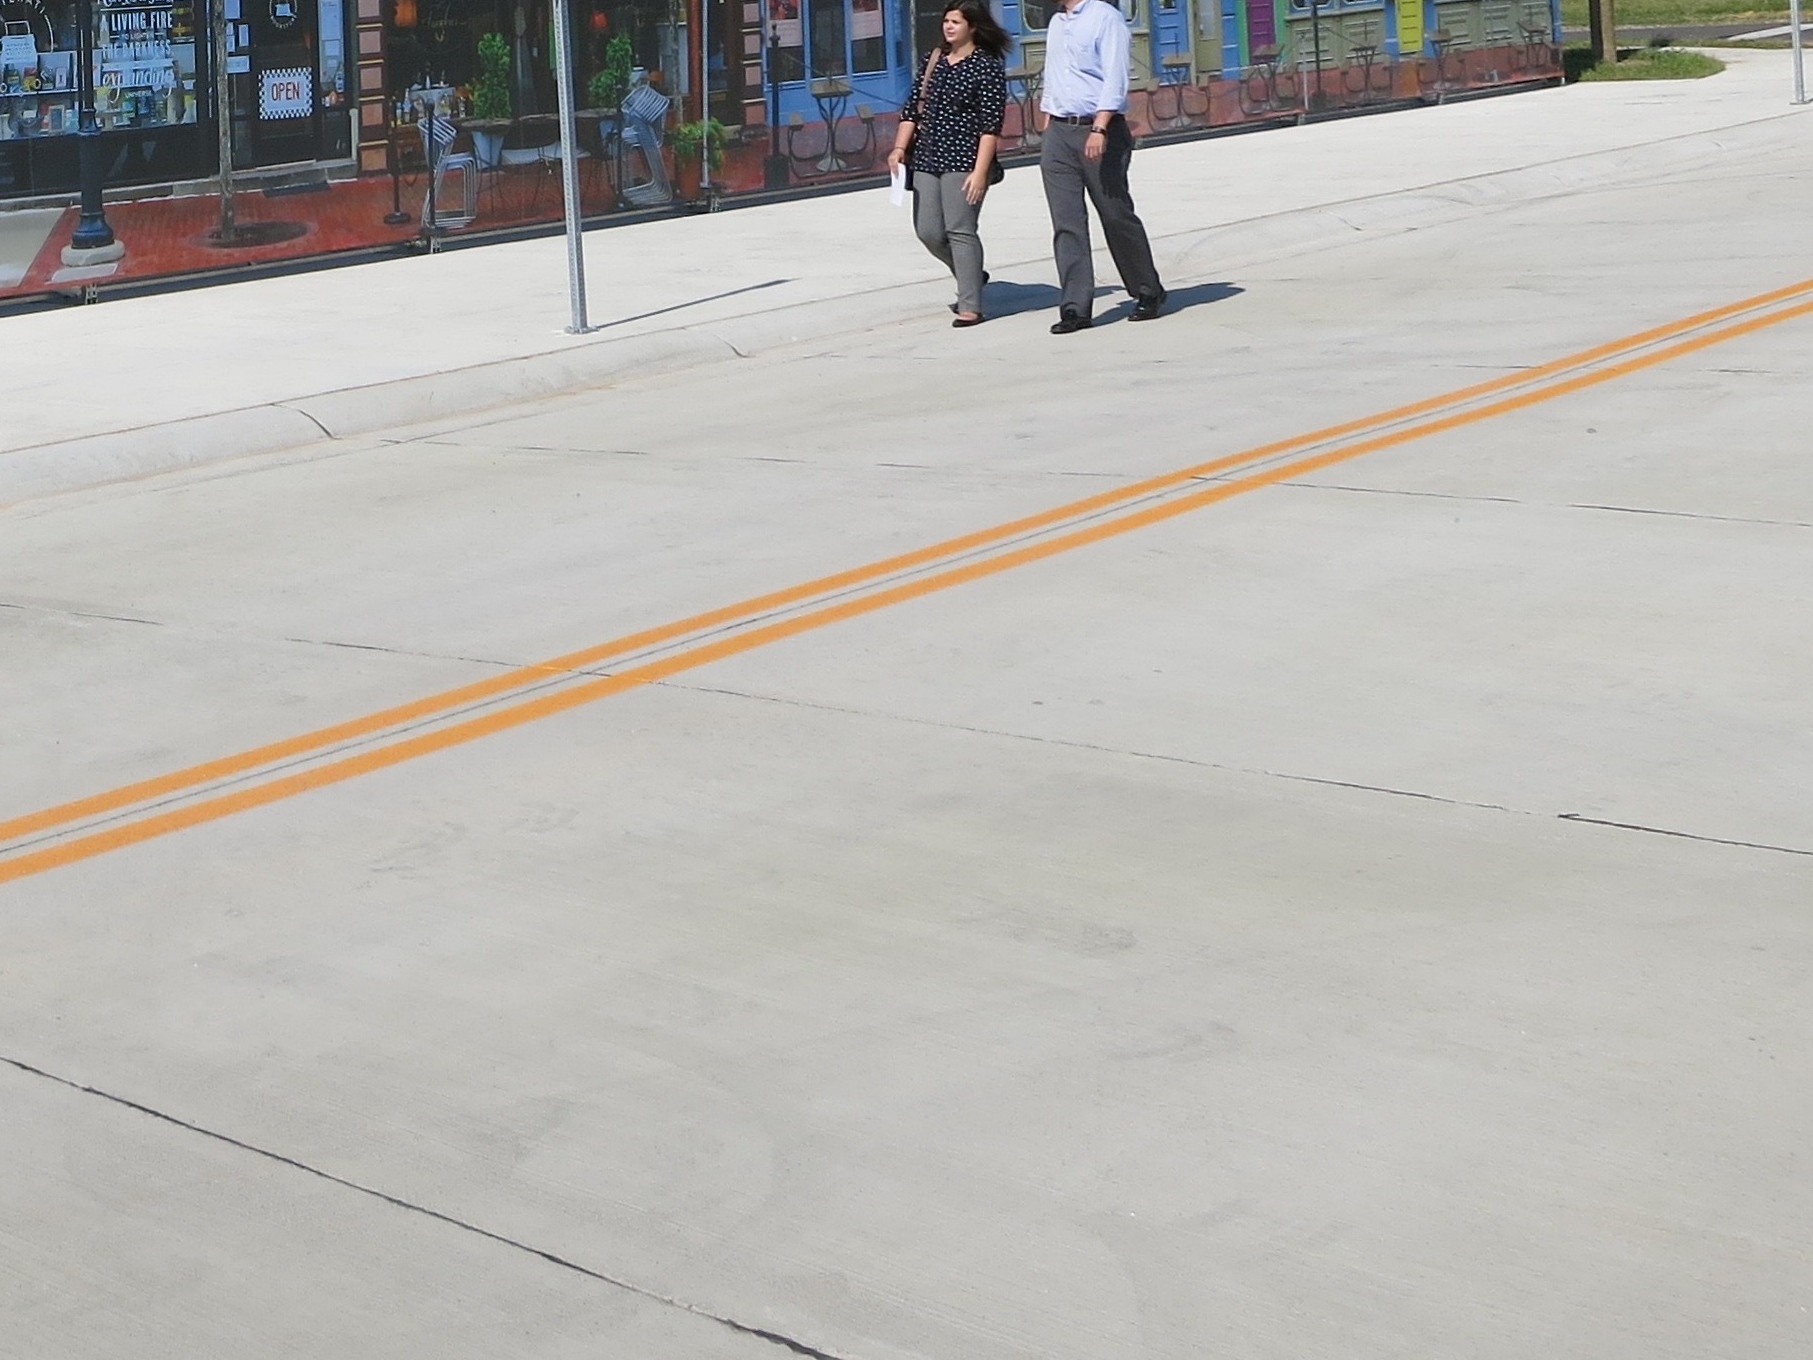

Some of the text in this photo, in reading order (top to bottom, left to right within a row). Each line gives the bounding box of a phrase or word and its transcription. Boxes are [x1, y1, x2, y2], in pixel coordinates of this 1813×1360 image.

[111, 11, 147, 31] LIVING
[151, 10, 173, 29] FIRE
[271, 81, 300, 101] OPEN
